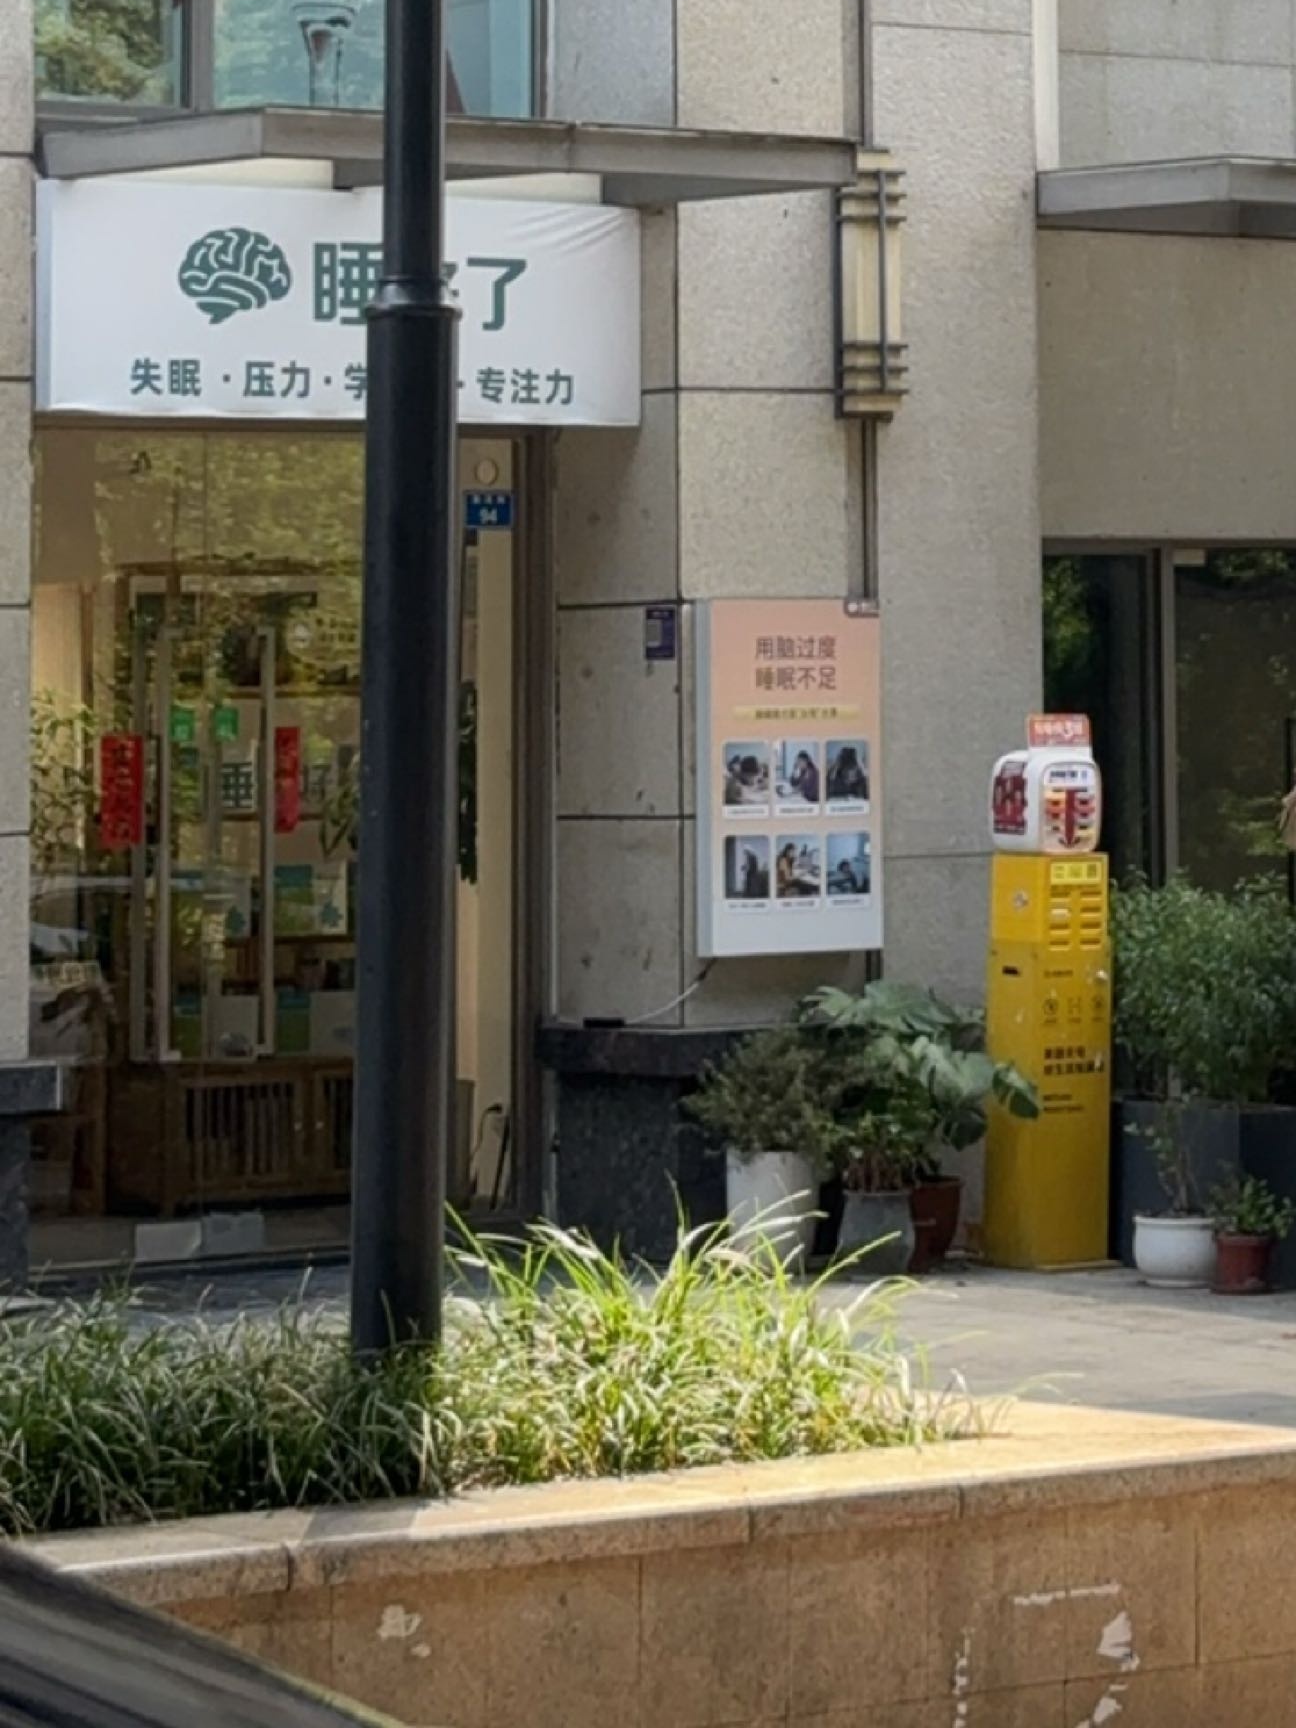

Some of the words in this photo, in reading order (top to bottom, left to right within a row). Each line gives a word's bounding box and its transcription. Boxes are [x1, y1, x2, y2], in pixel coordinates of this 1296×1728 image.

[313, 242, 527, 331] 睡了
[754, 635, 837, 660] 用脑过度
[755, 667, 837, 691] 睡眠不足
